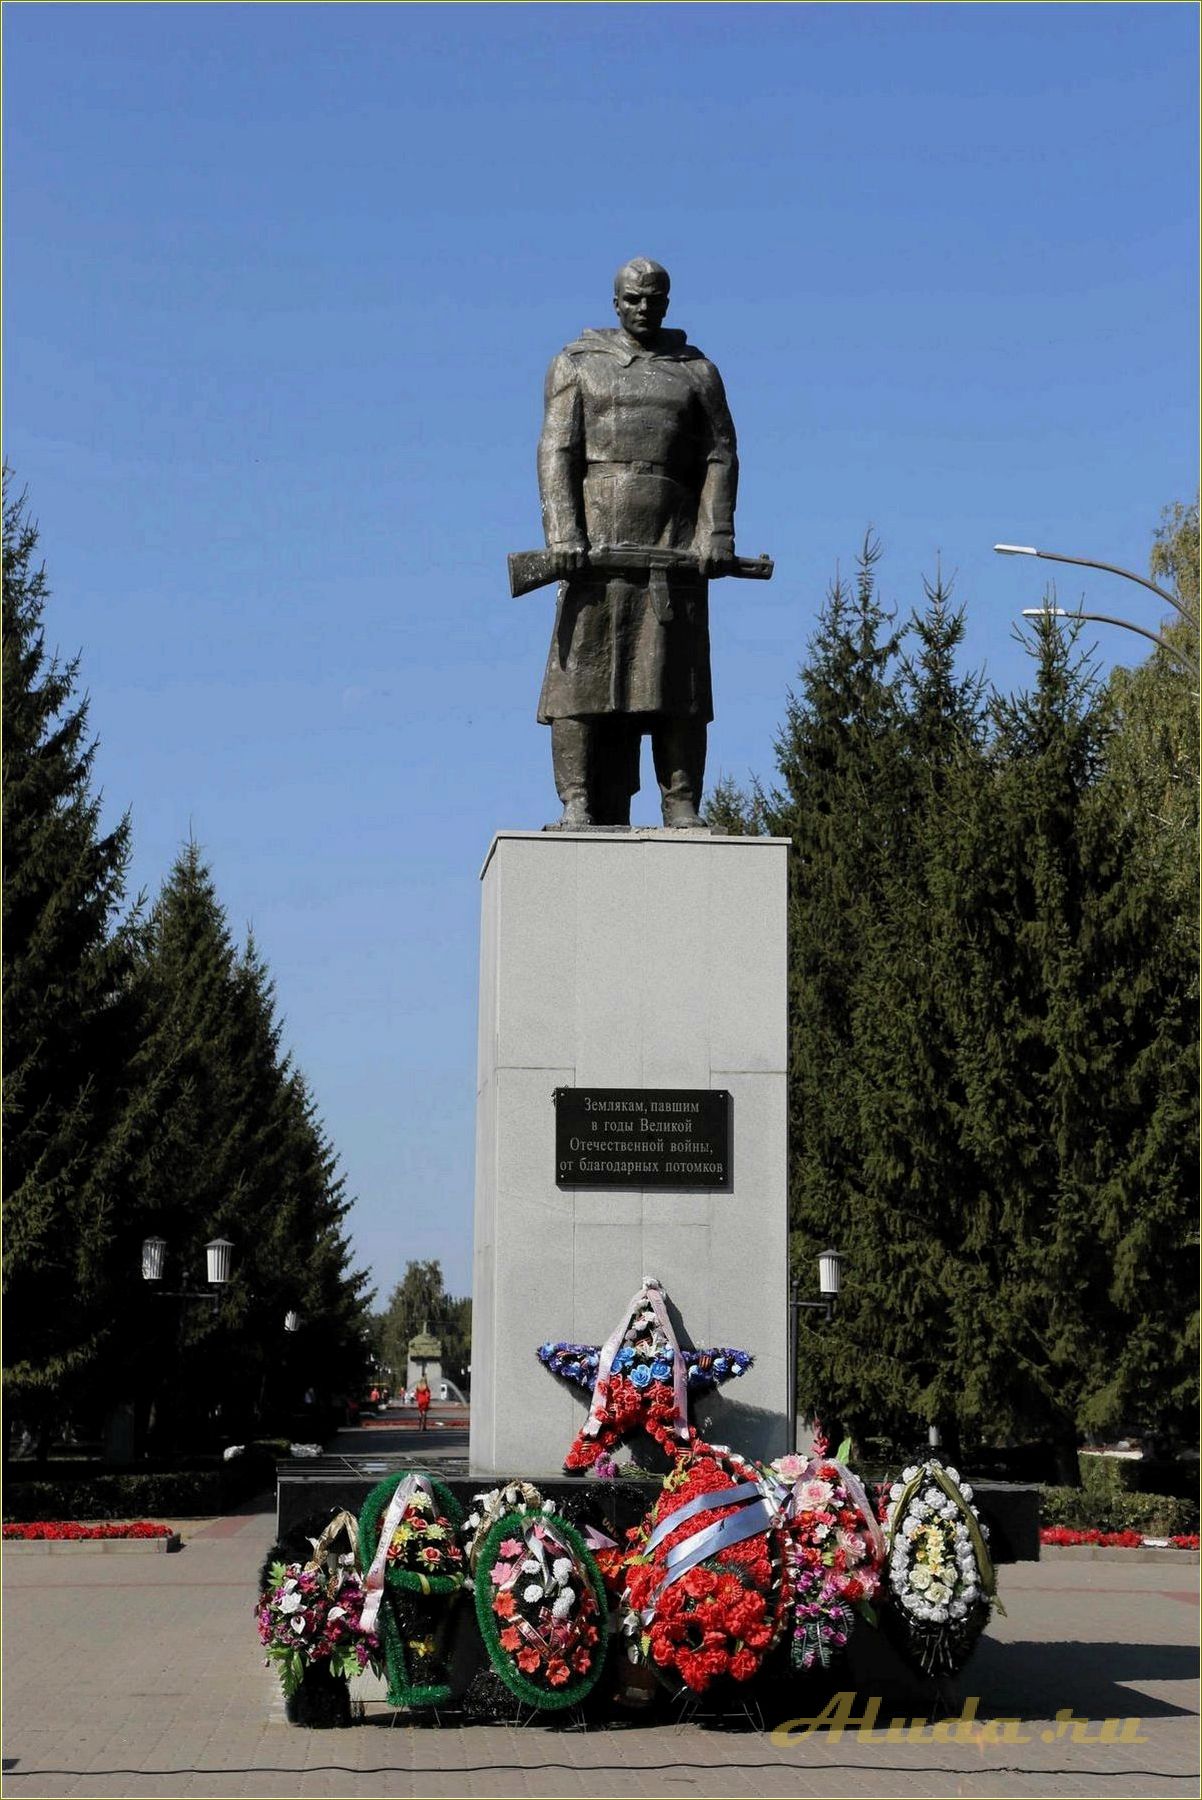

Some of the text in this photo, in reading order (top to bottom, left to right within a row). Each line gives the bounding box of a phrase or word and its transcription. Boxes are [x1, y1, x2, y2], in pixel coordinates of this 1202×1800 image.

[584, 1097, 699, 1114] Землякам, павшим
[591, 1118, 692, 1132] в годы Великой
[570, 1137, 713, 1155] Отечественной войны,
[559, 1157, 723, 1174] от благодарных потомков
